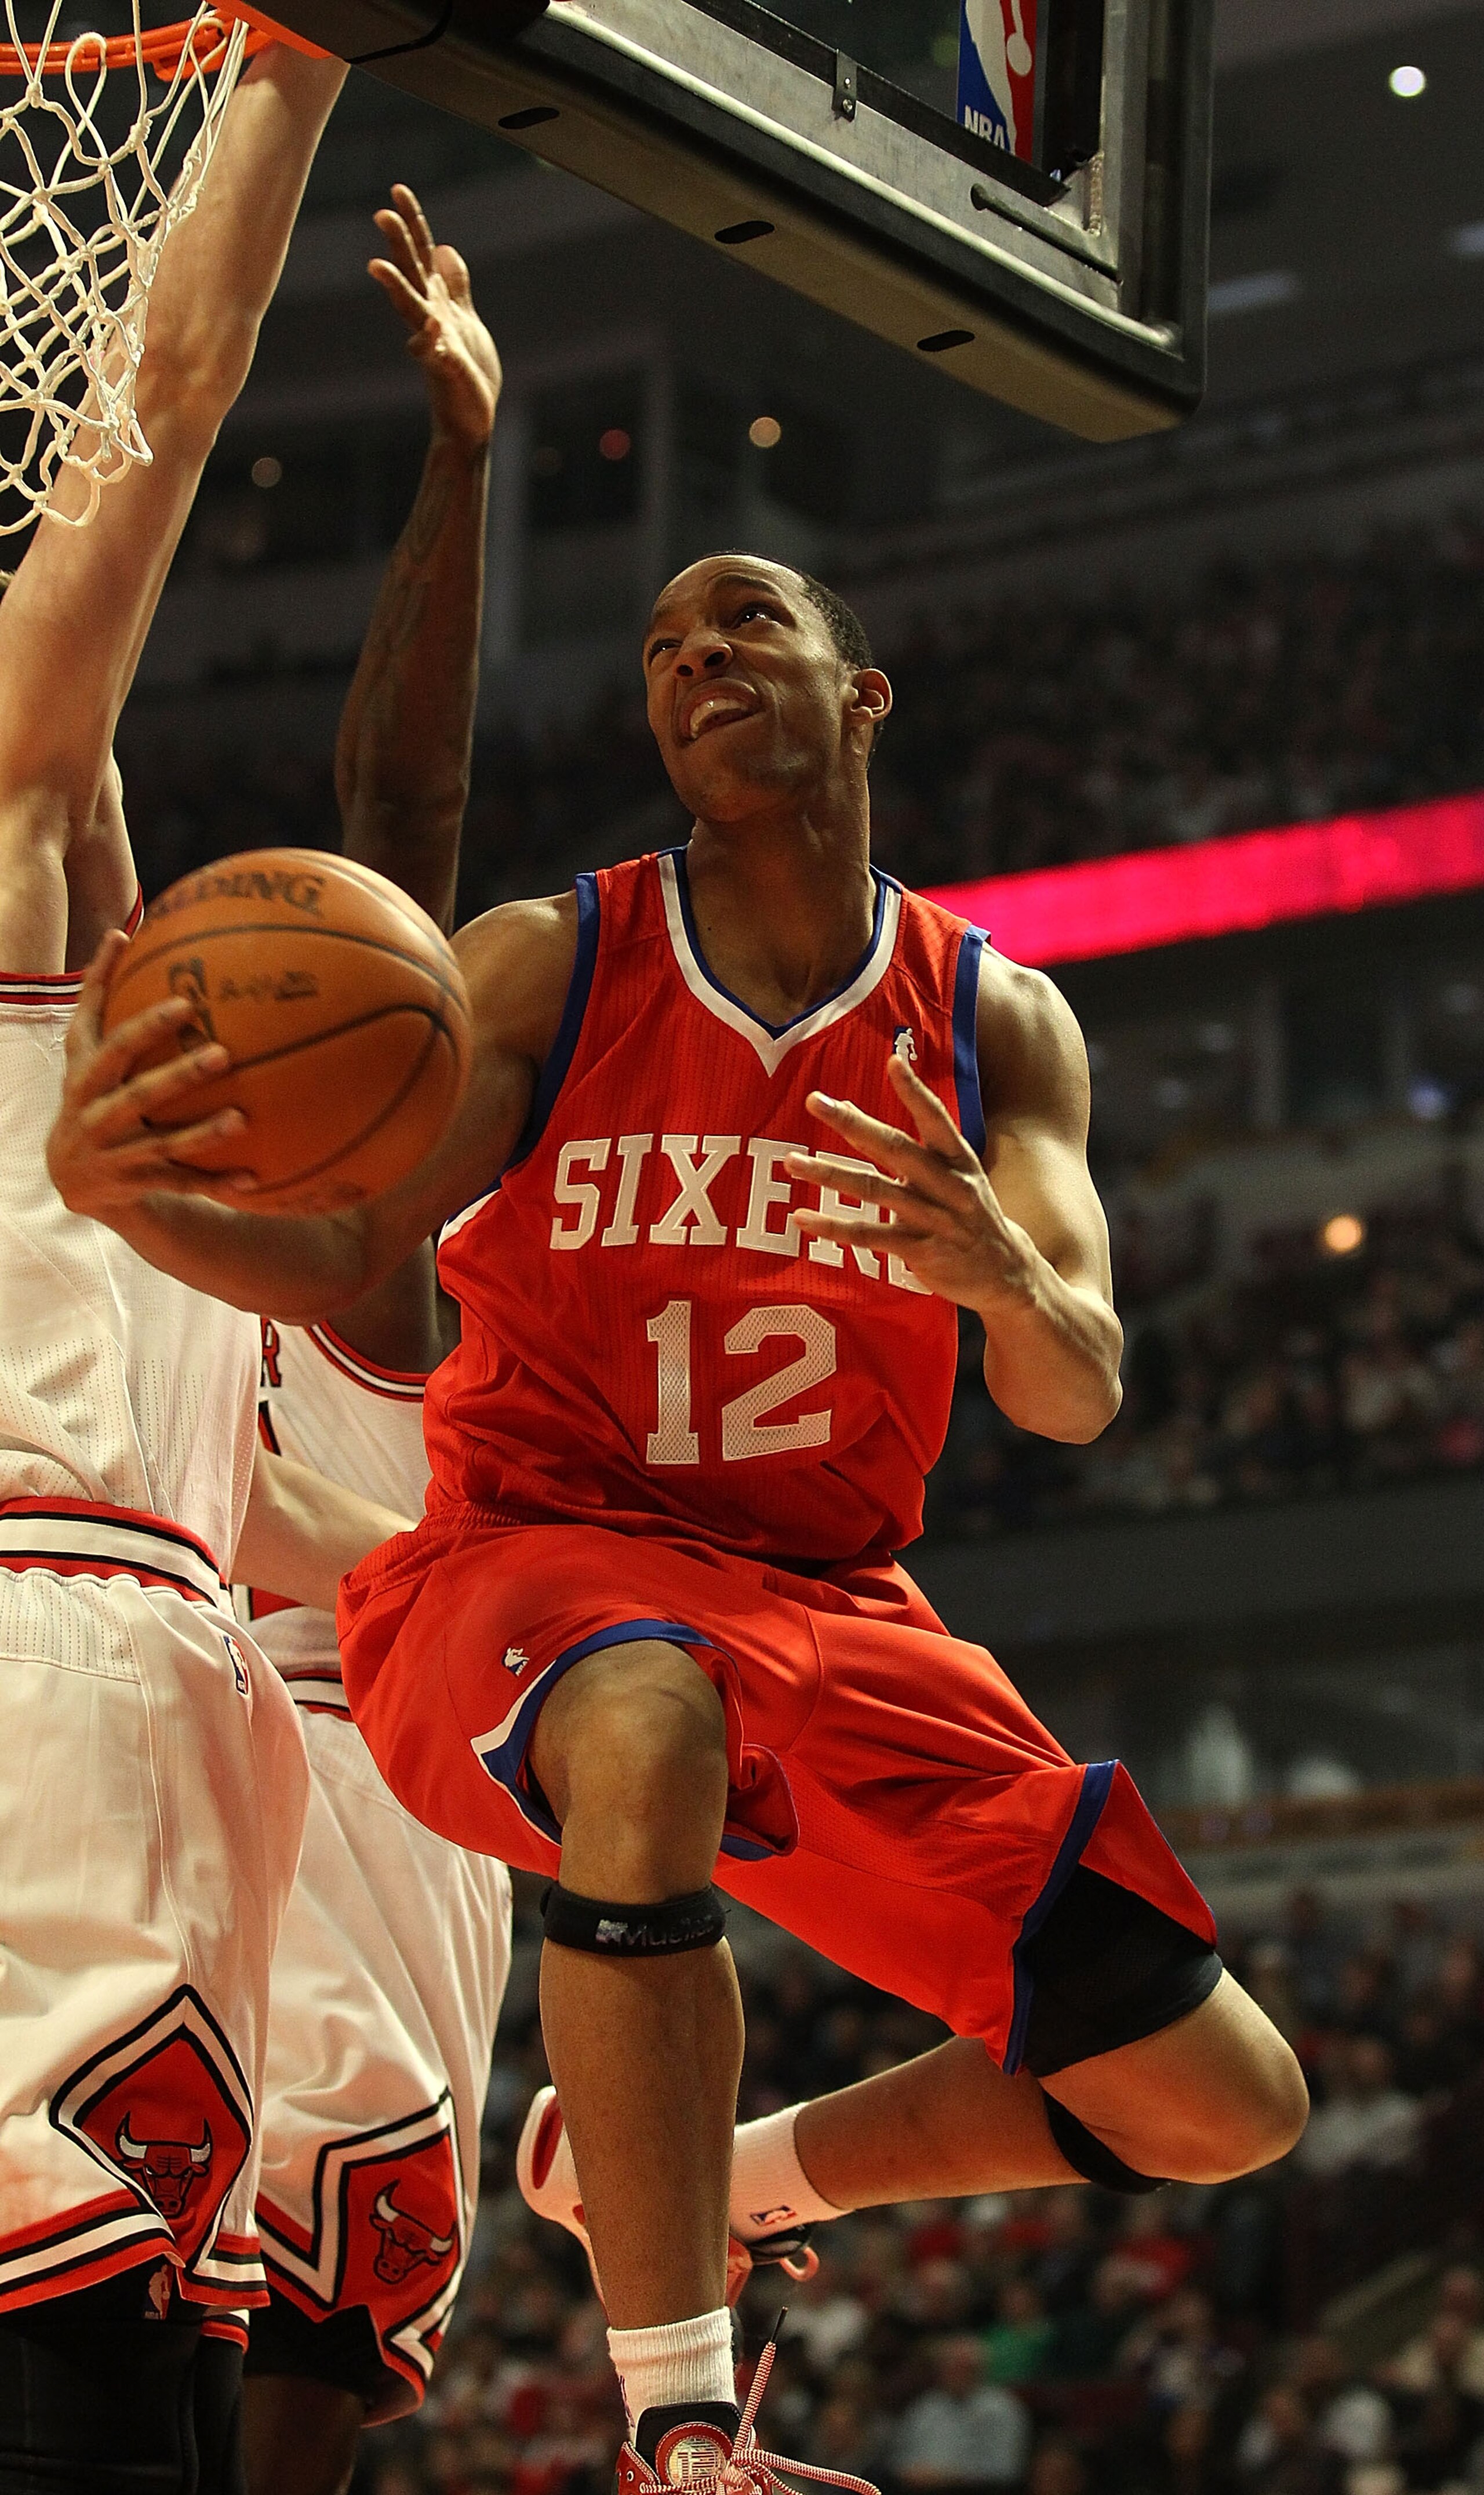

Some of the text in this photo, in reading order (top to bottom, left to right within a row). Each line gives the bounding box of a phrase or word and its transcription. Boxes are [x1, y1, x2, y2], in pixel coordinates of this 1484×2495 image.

[965, 105, 1005, 150] NBA
[550, 1133, 934, 1295] SIXER
[645, 1299, 837, 1465] 12
